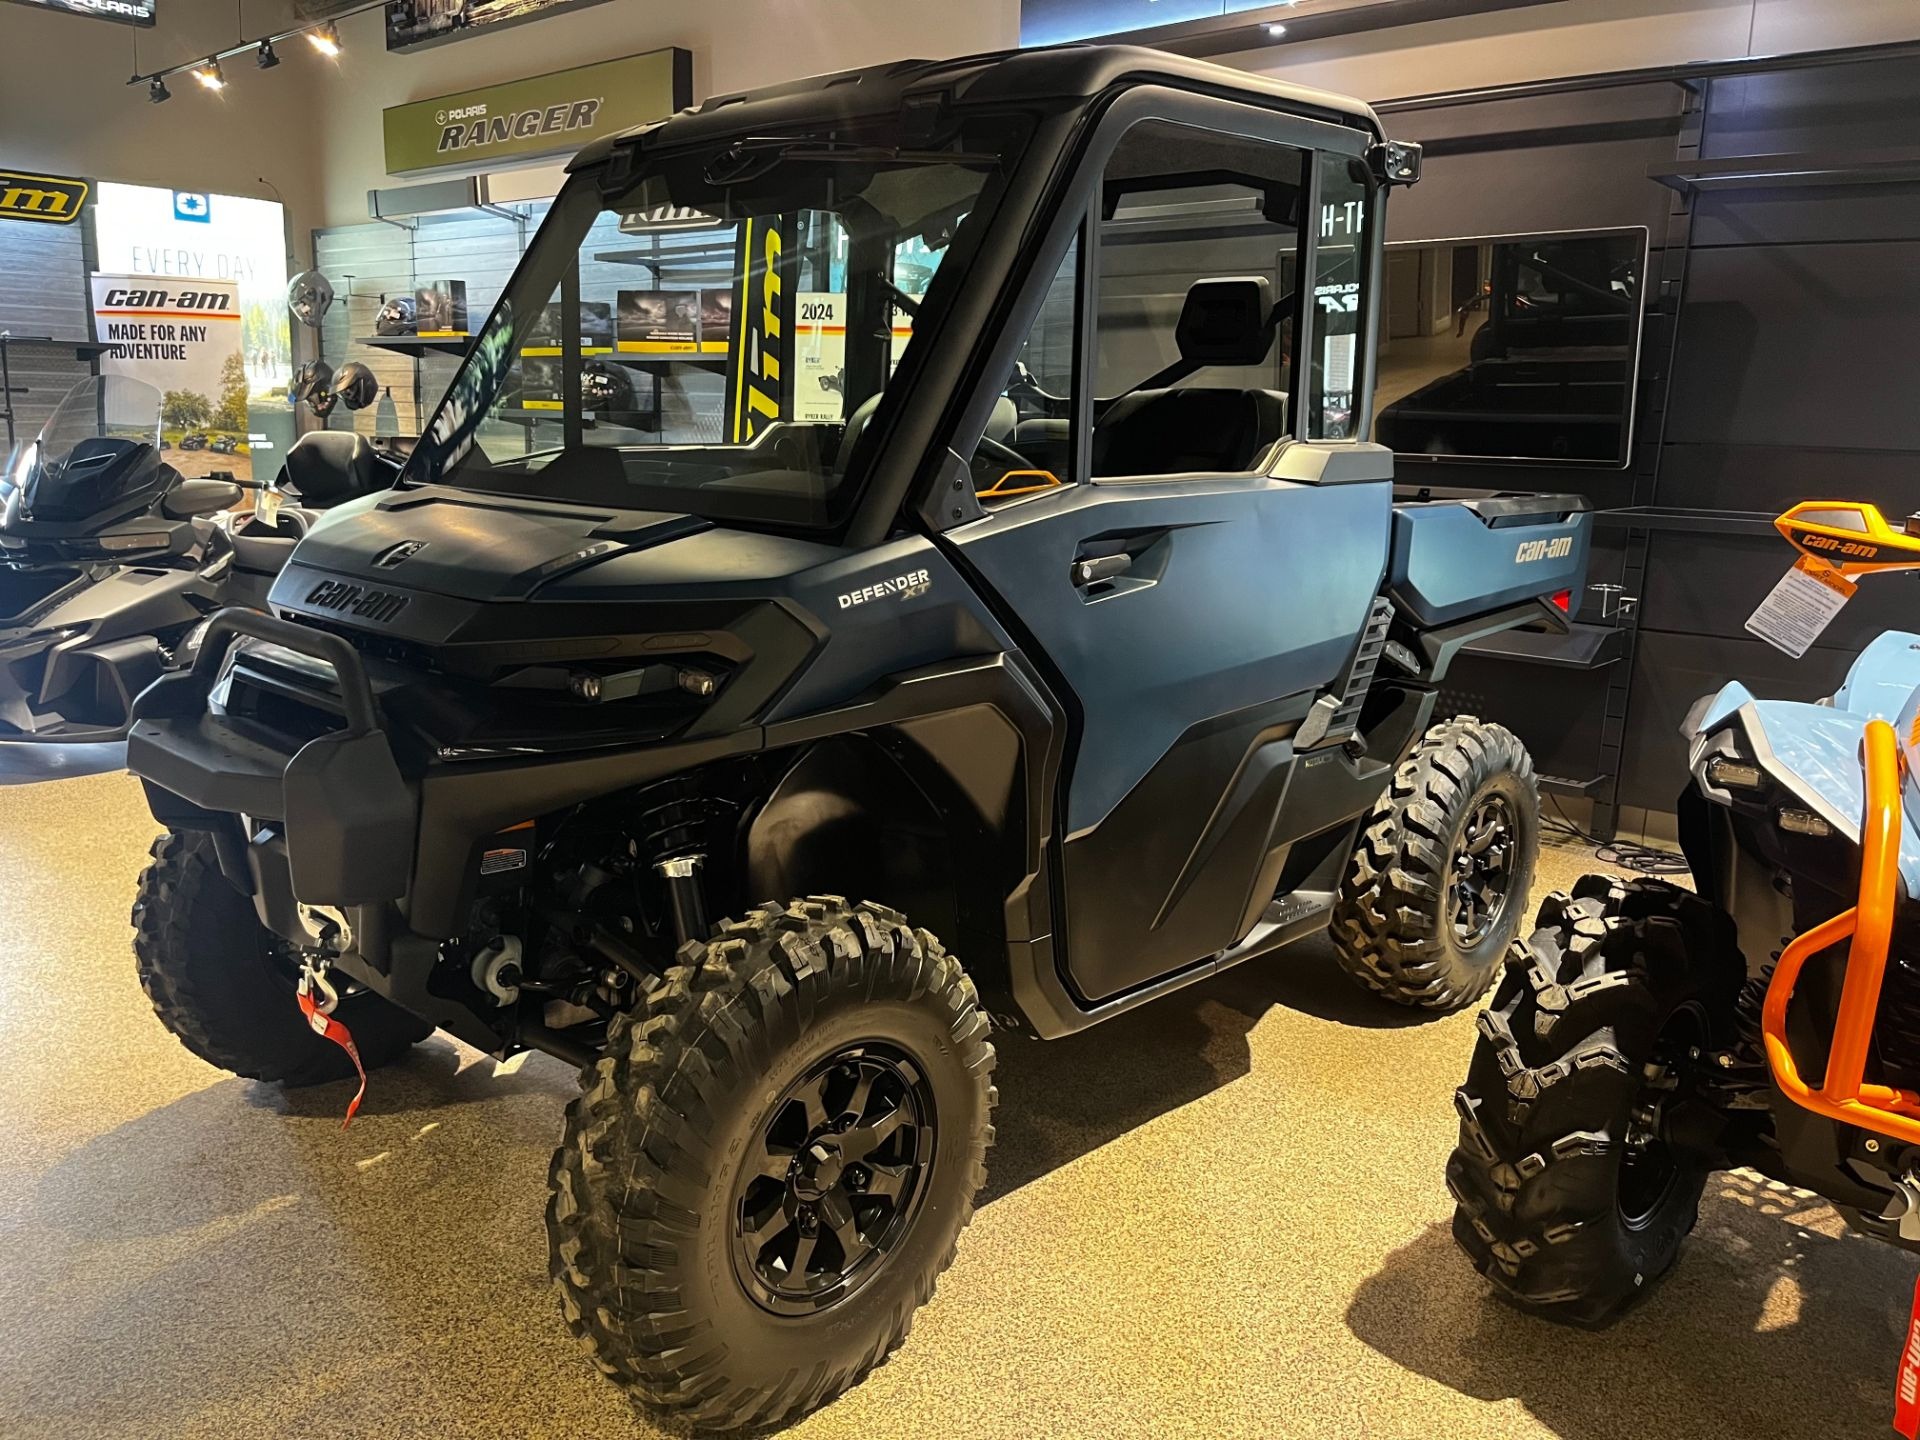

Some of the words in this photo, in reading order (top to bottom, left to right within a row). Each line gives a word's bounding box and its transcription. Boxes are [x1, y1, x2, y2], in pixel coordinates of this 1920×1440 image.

[76, 0, 150, 18] OLARIS
[449, 104, 487, 120] POLARIS
[437, 98, 600, 152] RANGER
[133, 246, 204, 277] EVERY
[217, 254, 256, 281] DAY
[105, 289, 230, 311] can-am
[801, 303, 834, 321] 2024
[108, 323, 147, 341] MADE
[151, 325, 176, 342] FOR
[180, 326, 207, 343] ANY
[109, 343, 187, 361] ADVENTURE
[1515, 536, 1573, 564] can-am
[1802, 534, 1878, 558] can-am
[838, 569, 930, 609] DEFENDER
[304, 580, 411, 623] can-am
